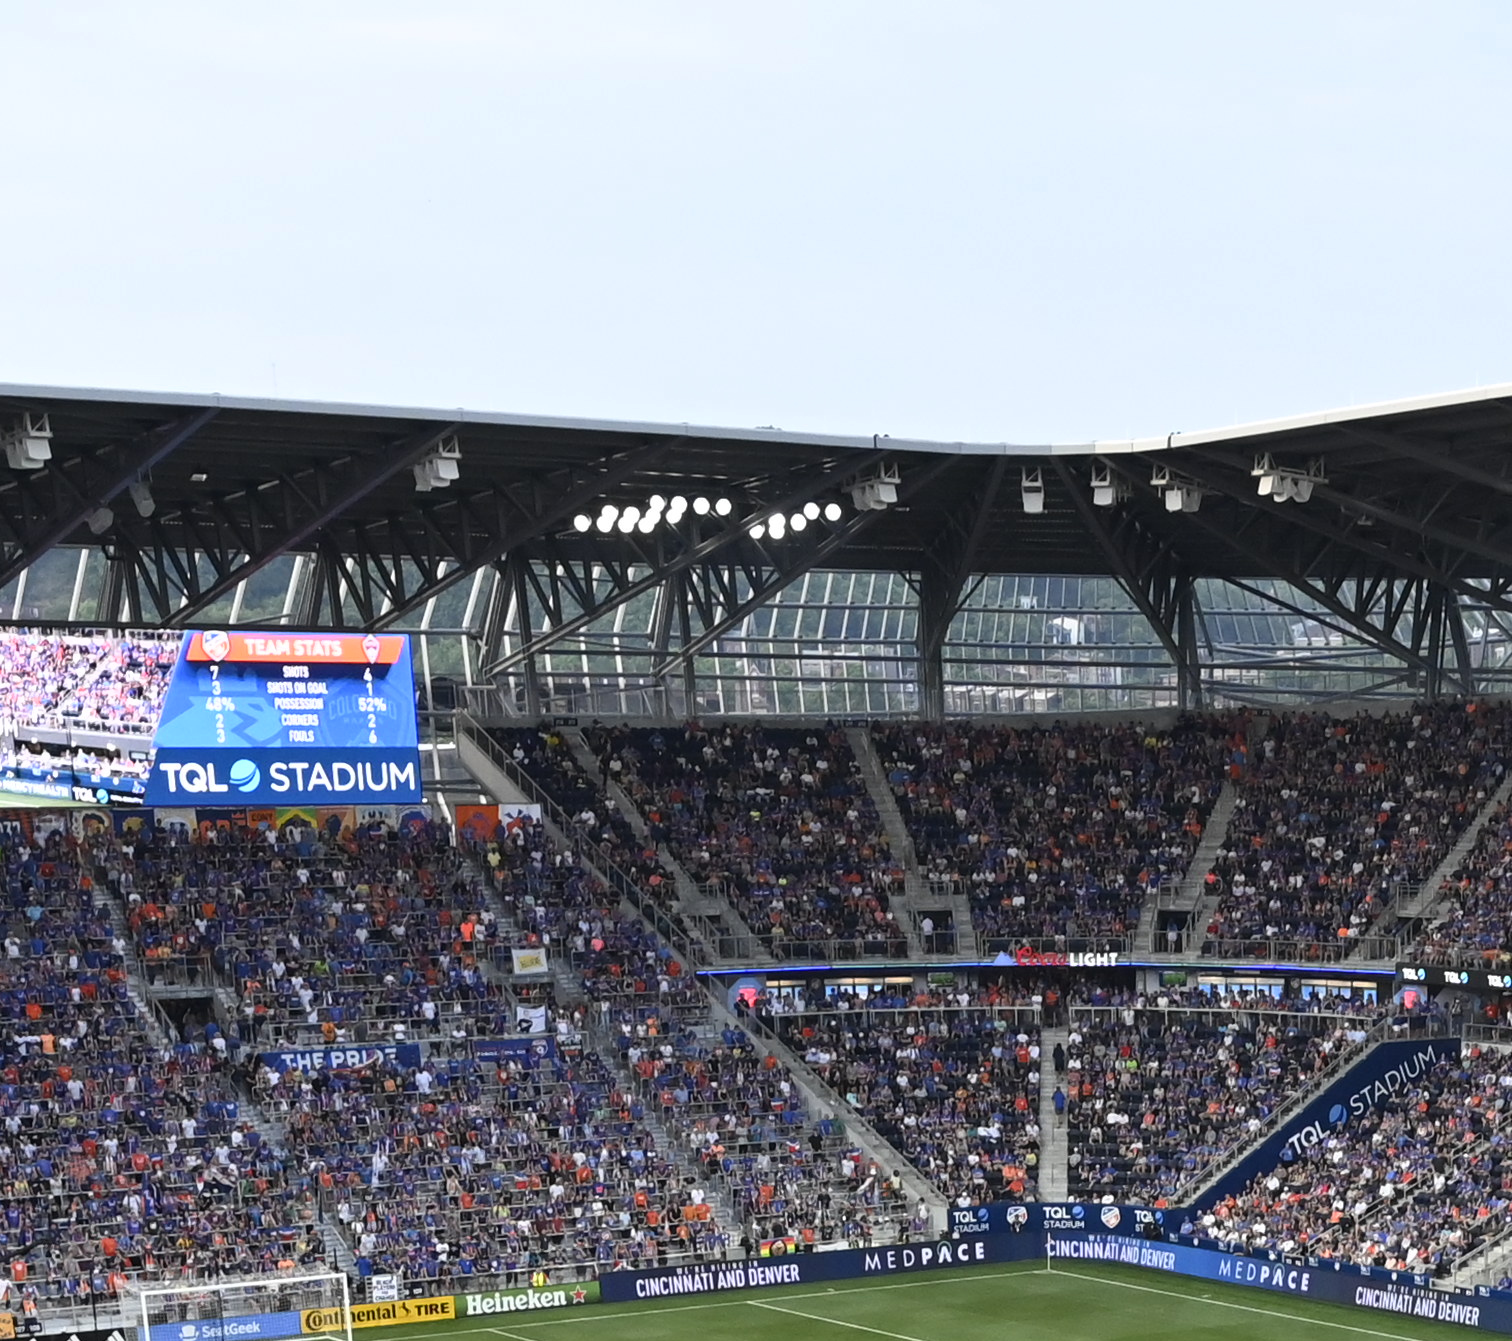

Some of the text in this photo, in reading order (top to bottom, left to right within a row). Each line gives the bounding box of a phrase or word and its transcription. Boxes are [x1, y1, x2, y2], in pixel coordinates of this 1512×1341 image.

[244, 639, 343, 657] TEAM STATS
[210, 665, 372, 681] 7 SHOTS 4
[212, 681, 373, 696] 3 SHOTS ON GOAL 1
[274, 697, 324, 710] POSSESSION
[358, 698, 387, 712] 52%
[215, 714, 376, 728] 2 CORNERS 2
[216, 730, 377, 743] 3 FOULS 6
[159, 762, 416, 793] TQL STADIUM
[1070, 952, 1118, 967] LIGHT
[280, 1053, 325, 1070] THE
[1288, 1045, 1437, 1155] TQL STADIUM
[953, 1211, 977, 1224] TQL
[1043, 1206, 1071, 1219] TQL
[953, 1222, 990, 1234] STADIUM
[1043, 1219, 1085, 1230] STADIUM
[865, 1240, 985, 1272] MEDPACE
[1048, 1239, 1119, 1262] CINCINNATI
[1120, 1244, 1140, 1264] AND
[1140, 1247, 1176, 1271] DENVER
[636, 1269, 716, 1298] CINCINNATI
[717, 1268, 746, 1288] AND
[748, 1263, 800, 1287] DENVER
[1218, 1258, 1311, 1292] MEDPACE
[466, 1289, 567, 1316] Heineken
[1356, 1286, 1412, 1315] CINCINNATI
[1413, 1296, 1437, 1319] AND
[1438, 1300, 1480, 1327] DENVER
[305, 1302, 450, 1331] Contnental TIRE
[202, 1321, 261, 1338] SeatGeek
